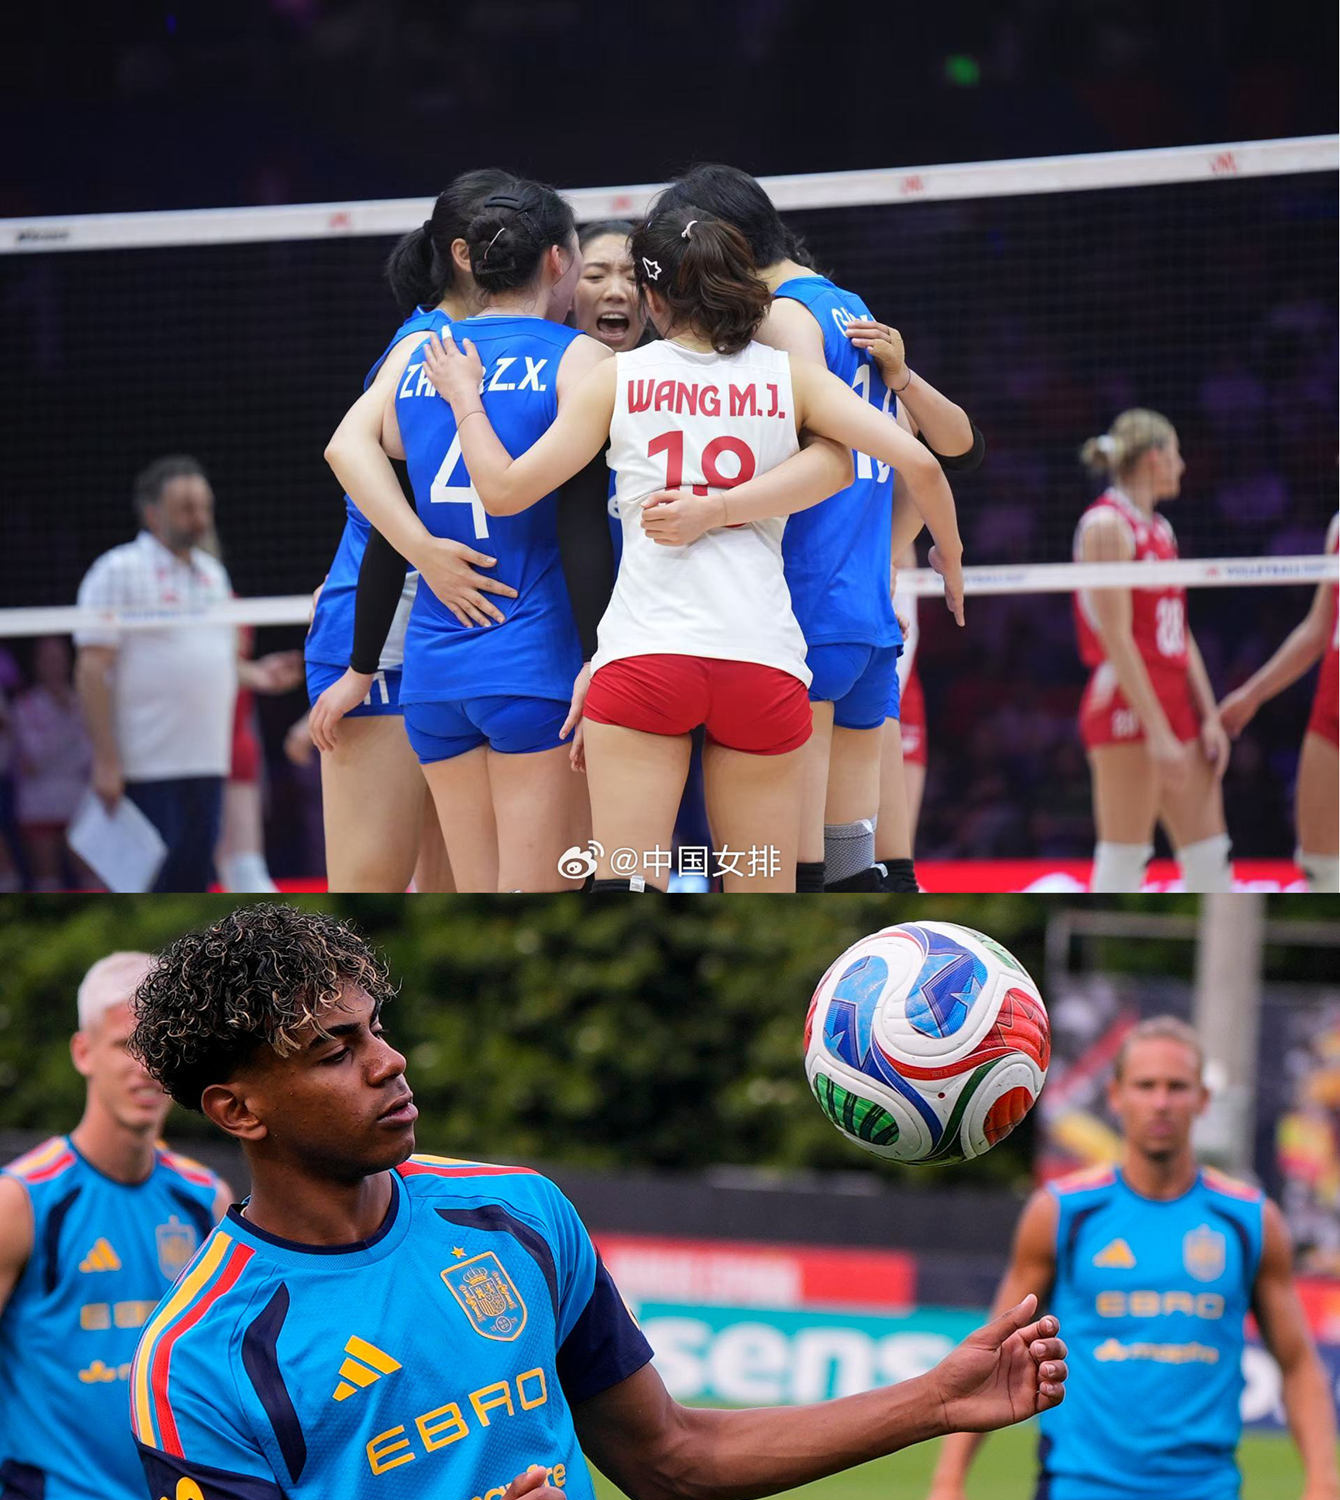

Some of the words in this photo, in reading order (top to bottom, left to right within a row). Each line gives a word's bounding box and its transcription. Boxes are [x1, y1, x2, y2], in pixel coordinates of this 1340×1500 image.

[488, 356, 548, 392] Z.X.
[627, 378, 721, 417] WANG
[728, 382, 786, 419] M.J.
[430, 425, 490, 539] 4
[366, 1367, 548, 1476] EBRO
